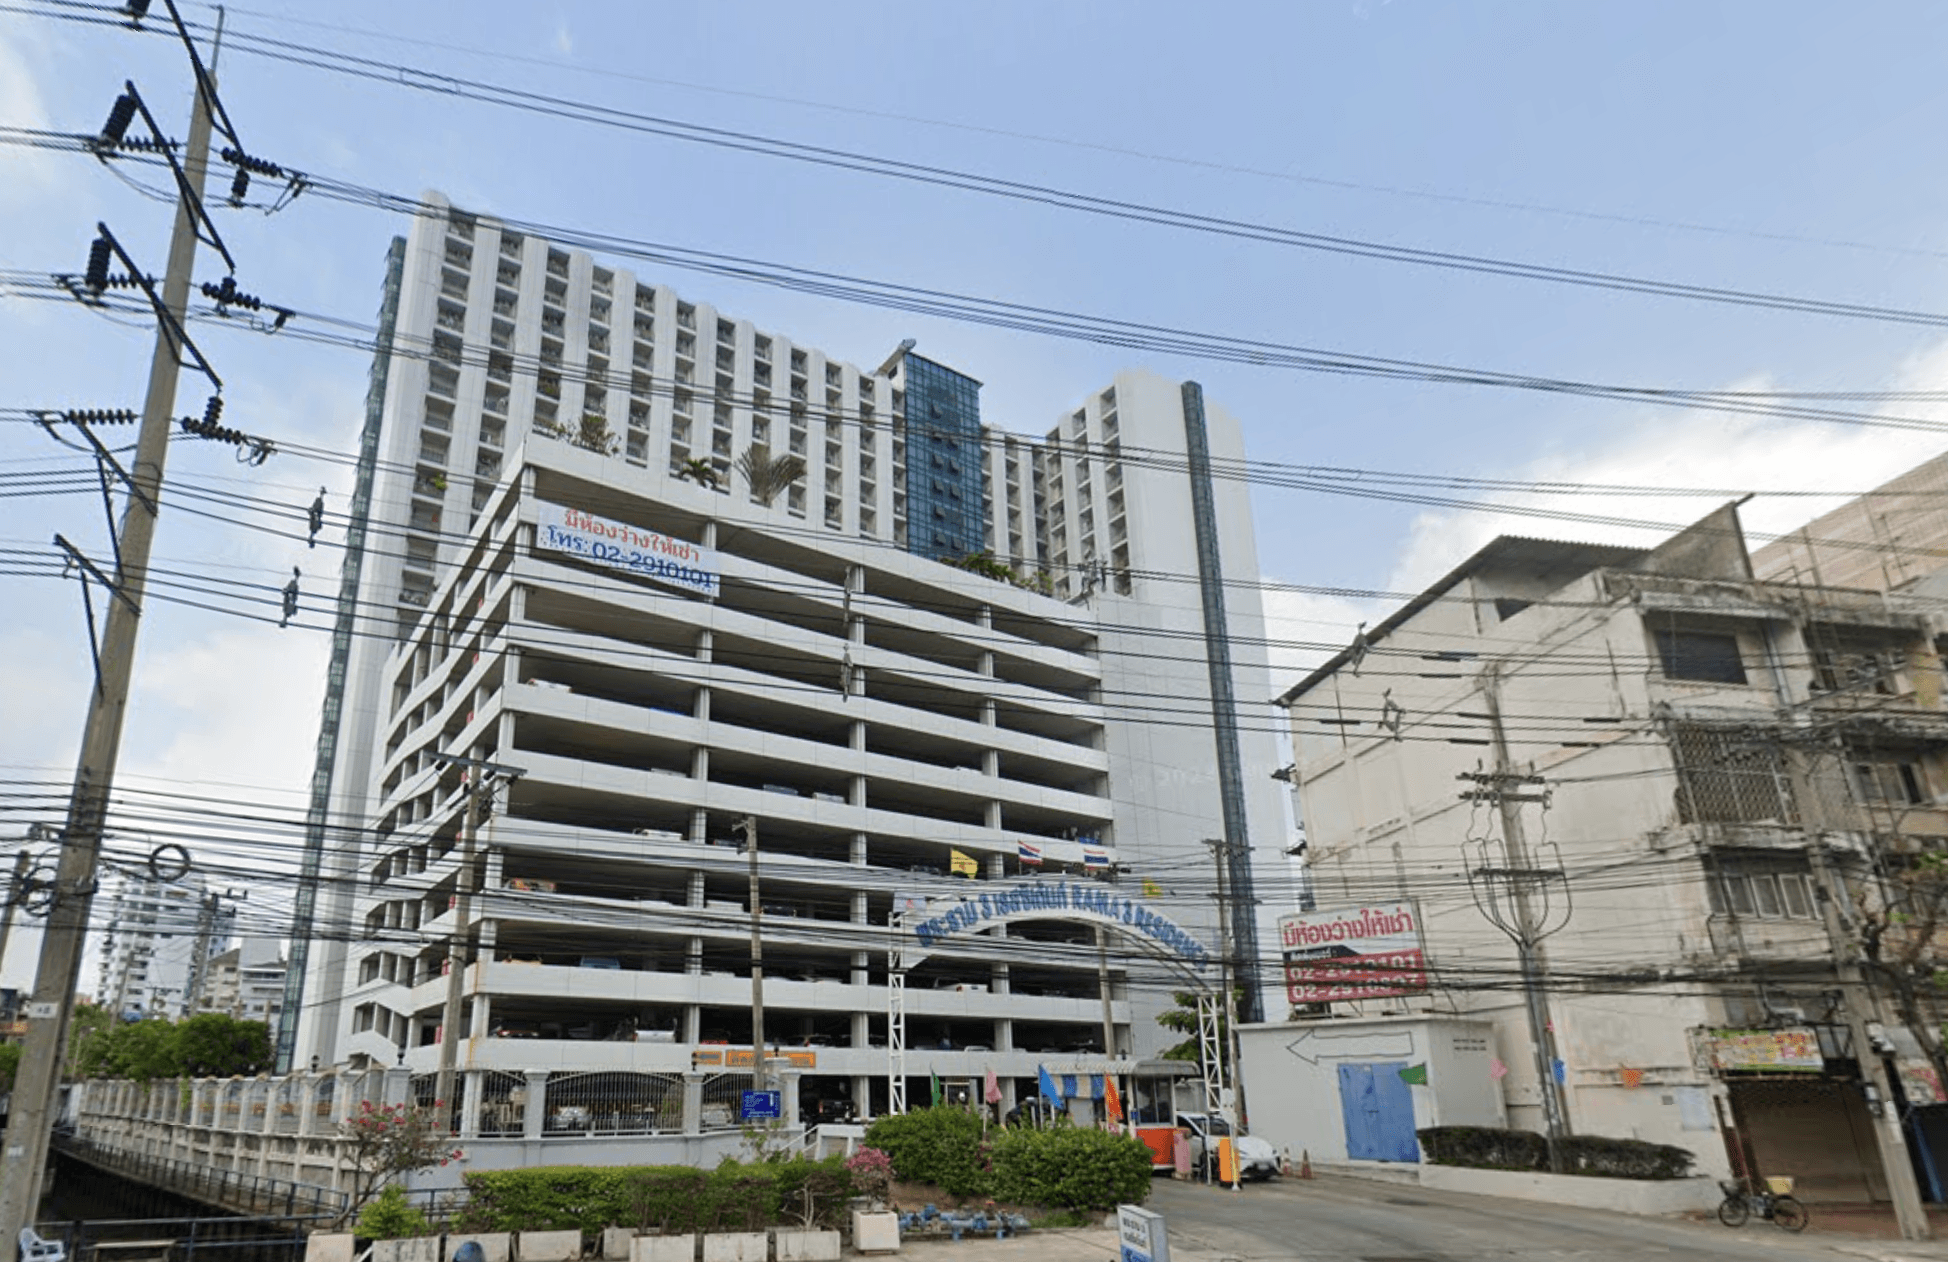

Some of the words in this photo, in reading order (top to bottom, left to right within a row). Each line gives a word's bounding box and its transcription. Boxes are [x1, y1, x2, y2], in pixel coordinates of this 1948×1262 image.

[565, 508, 699, 562] มีห้องว่างให้เช่า
[592, 541, 713, 588] 02-2910101
[1071, 884, 1120, 920] RAMA
[1122, 899, 1133, 925] 3
[1283, 906, 1414, 946] มีห้องว่างให้เช่า
